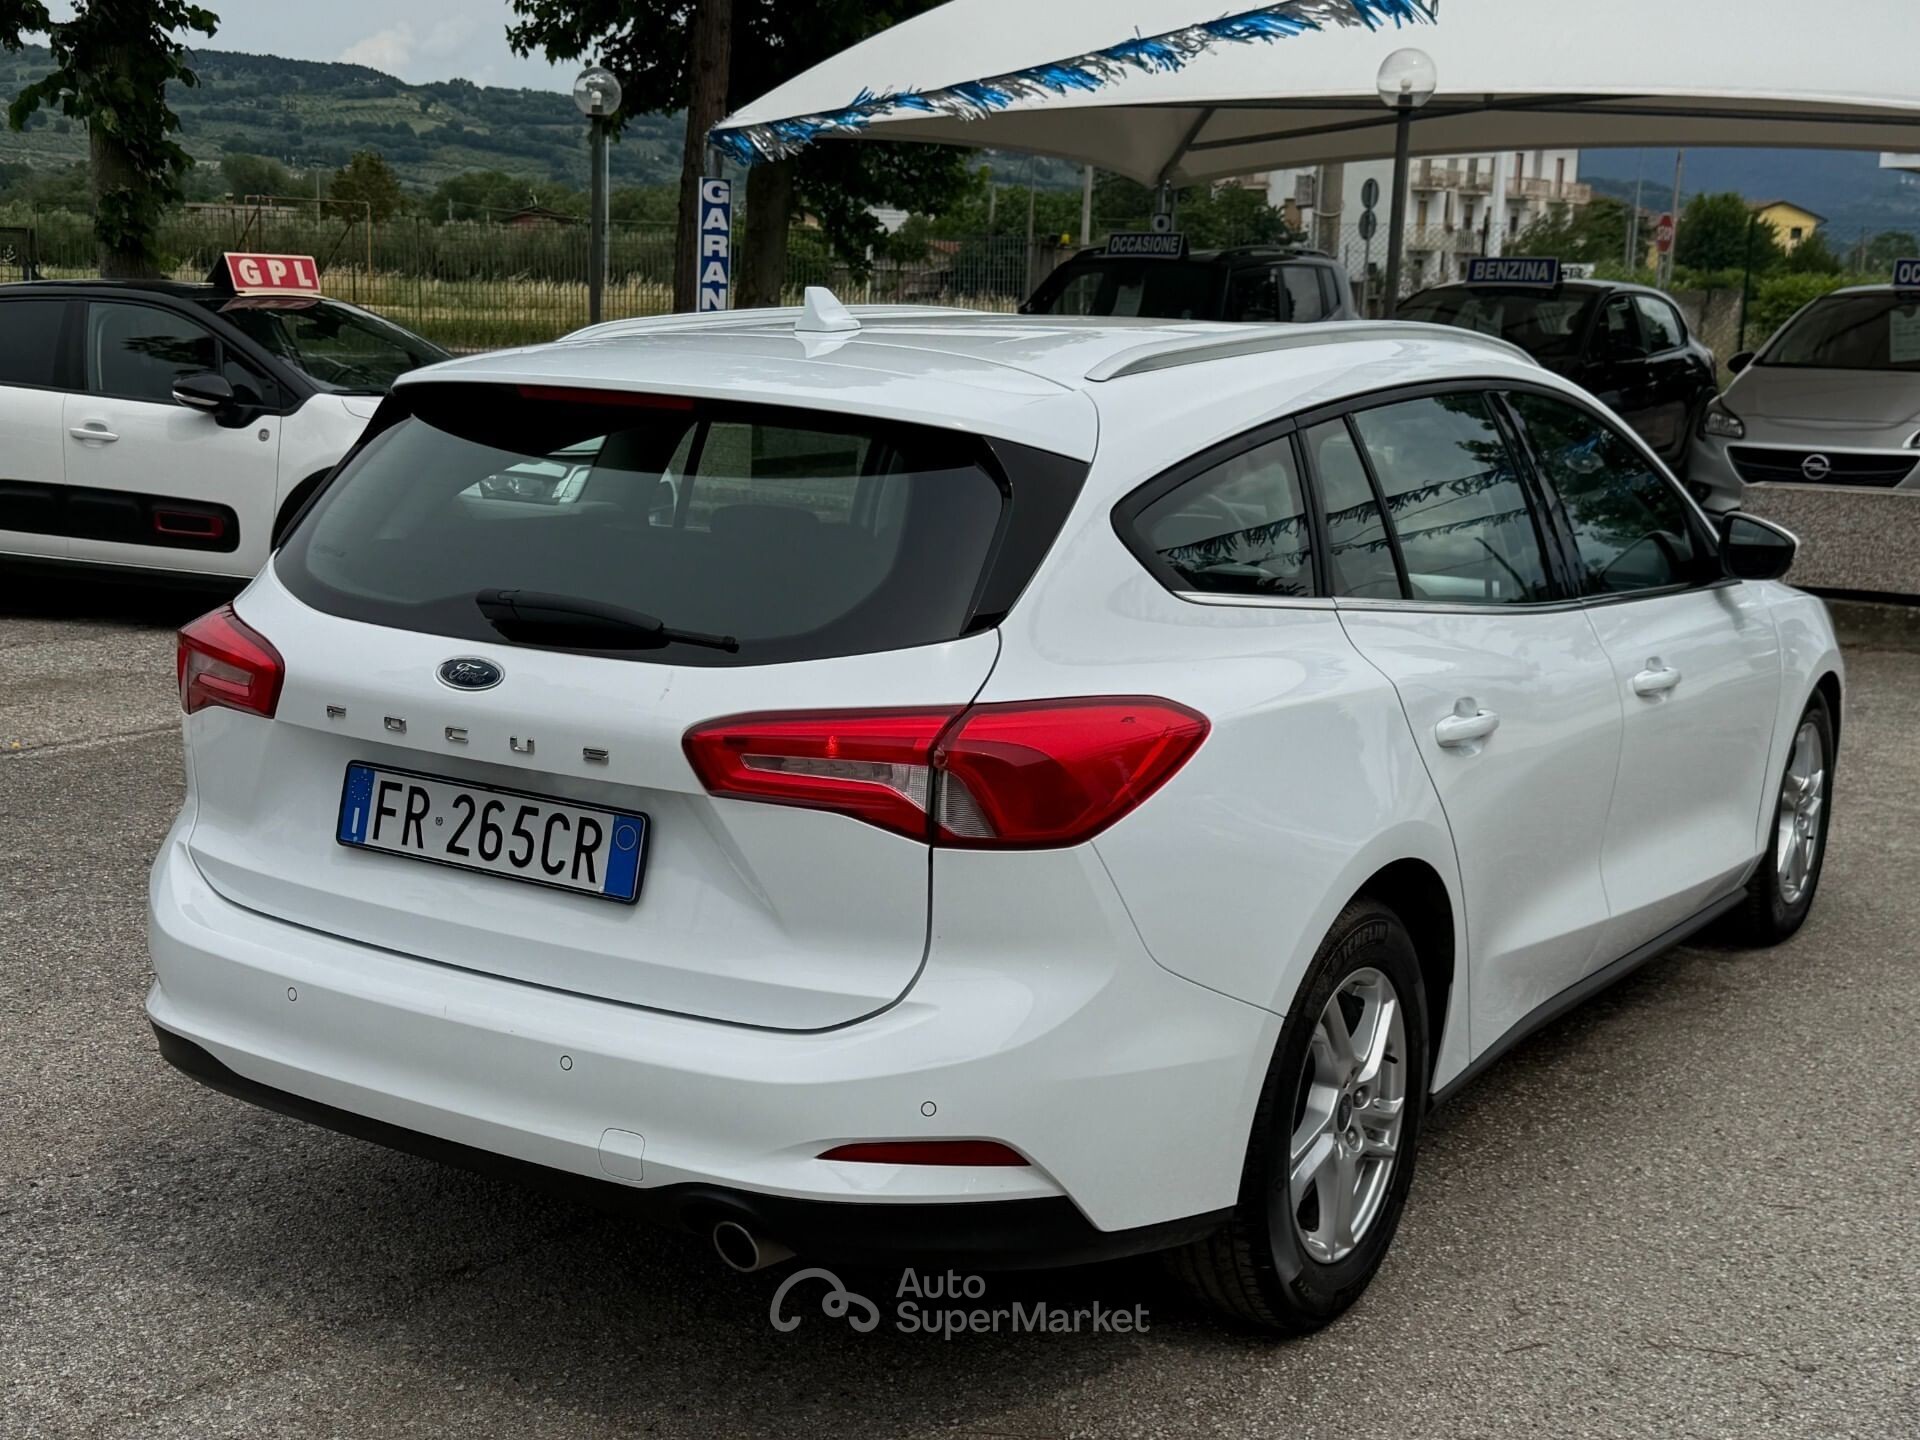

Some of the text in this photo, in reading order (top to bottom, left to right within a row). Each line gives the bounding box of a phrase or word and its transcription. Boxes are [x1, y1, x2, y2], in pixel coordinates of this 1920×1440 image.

[1110, 235, 1179, 253] OCCASIONE
[238, 258, 313, 287] GPL
[1472, 261, 1549, 280] BENZINA
[326, 704, 610, 765] FOCUS
[373, 780, 603, 884] FR 265CR
